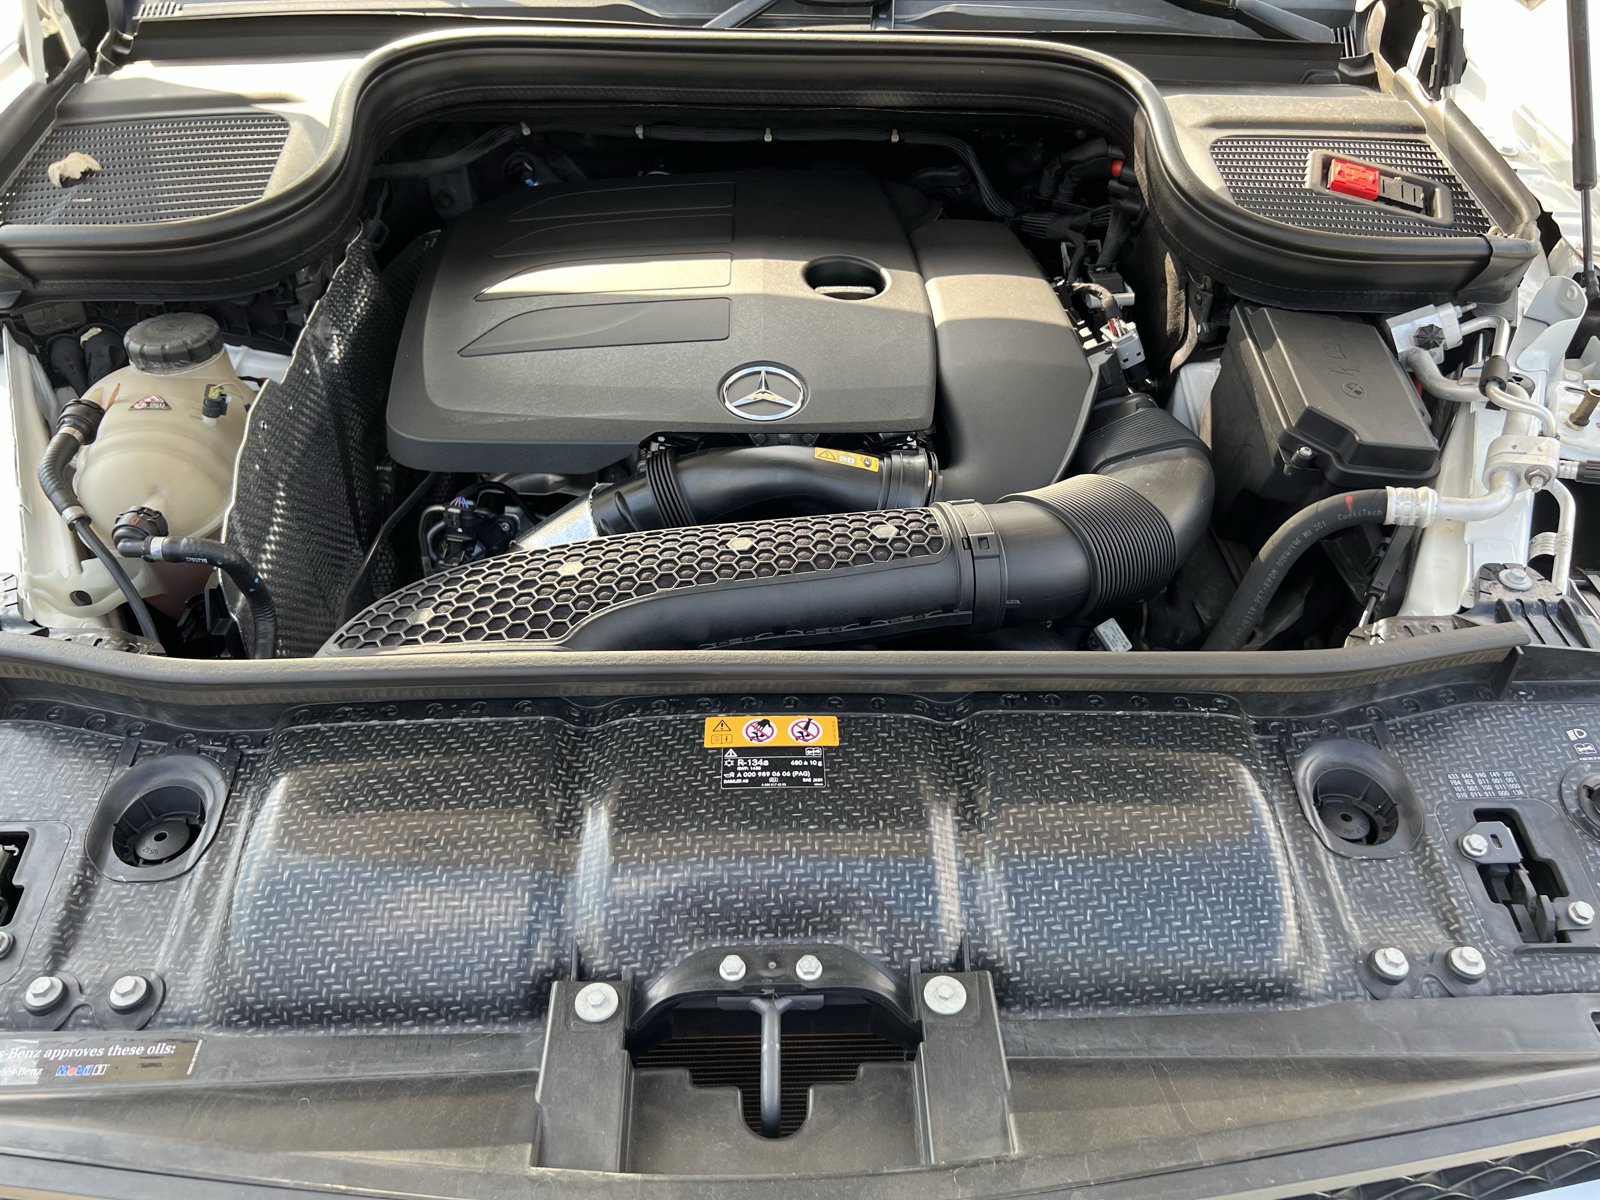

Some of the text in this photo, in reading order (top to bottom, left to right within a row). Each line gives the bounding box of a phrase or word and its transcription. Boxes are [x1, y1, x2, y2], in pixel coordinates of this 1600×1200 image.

[1337, 508, 1383, 521] ContiTech
[43, 1046, 105, 1061] approves
[107, 1044, 143, 1056] these
[147, 1042, 177, 1055] oils:
